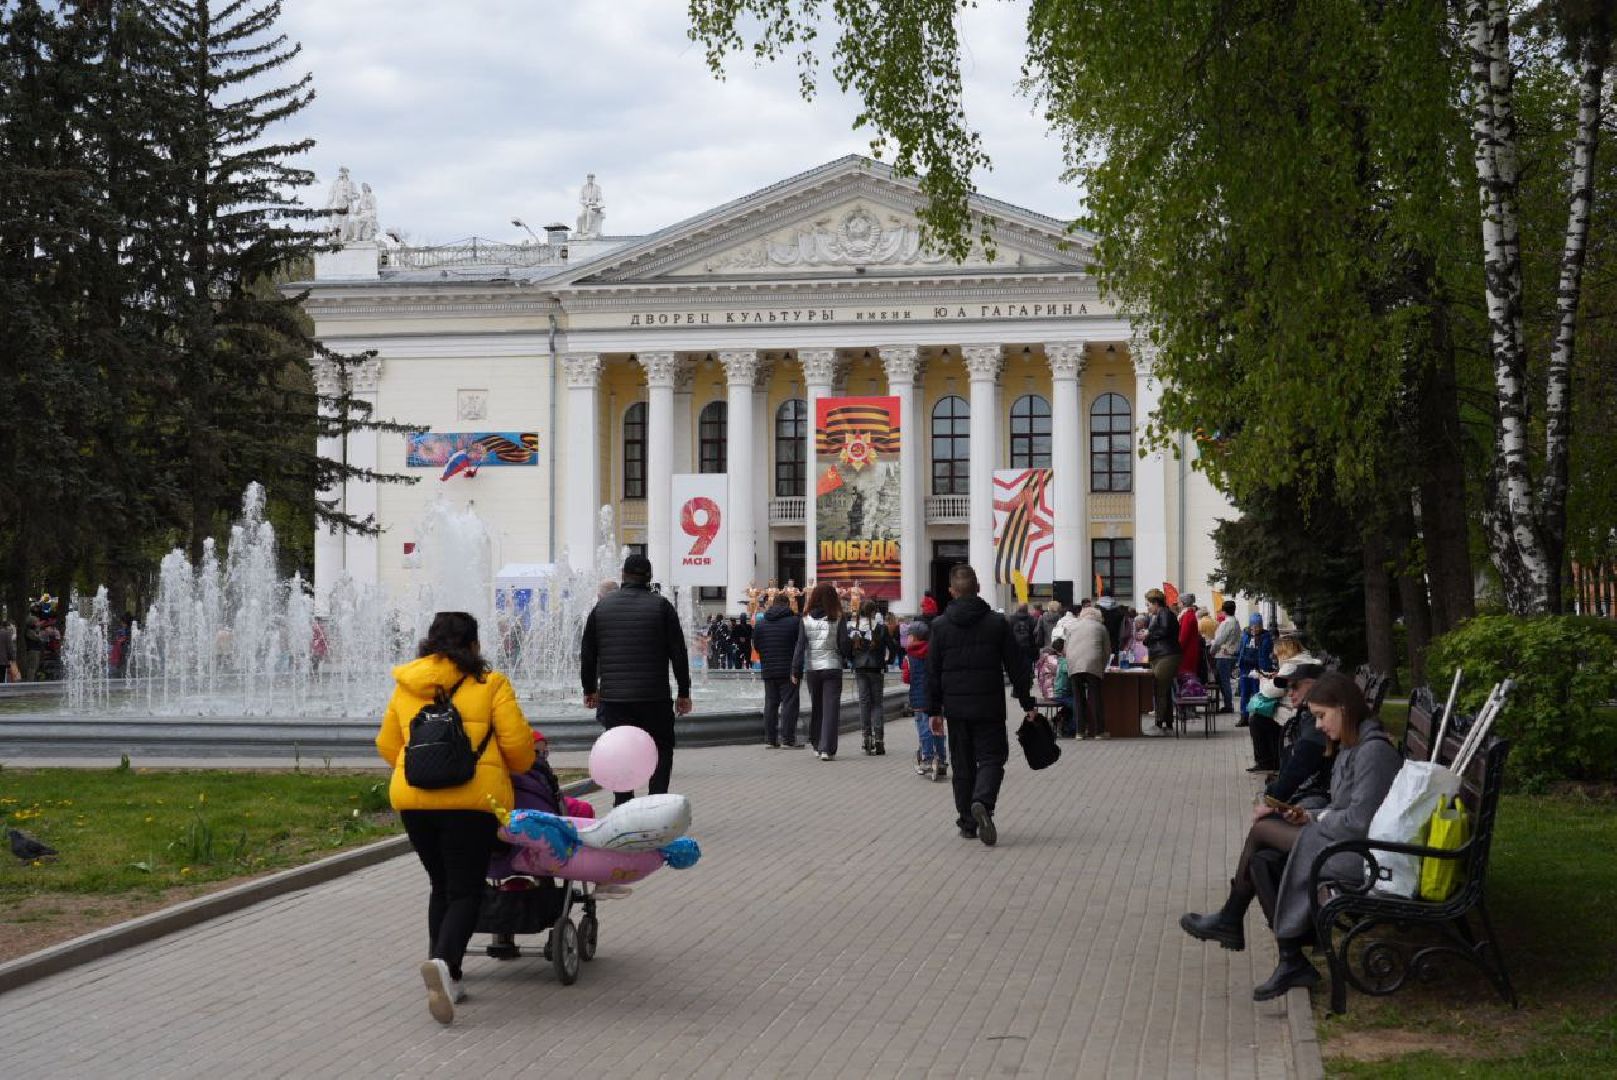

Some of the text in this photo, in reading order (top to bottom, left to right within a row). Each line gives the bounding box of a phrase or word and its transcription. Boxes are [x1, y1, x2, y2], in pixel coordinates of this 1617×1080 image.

[630, 312, 709, 325] ДВОРЕЦ
[726, 309, 834, 323] КУЛЬТУРЫ
[981, 303, 1087, 317] ГАГАРИНА
[680, 496, 721, 556] 9
[820, 539, 898, 566] ПОБЕДА
